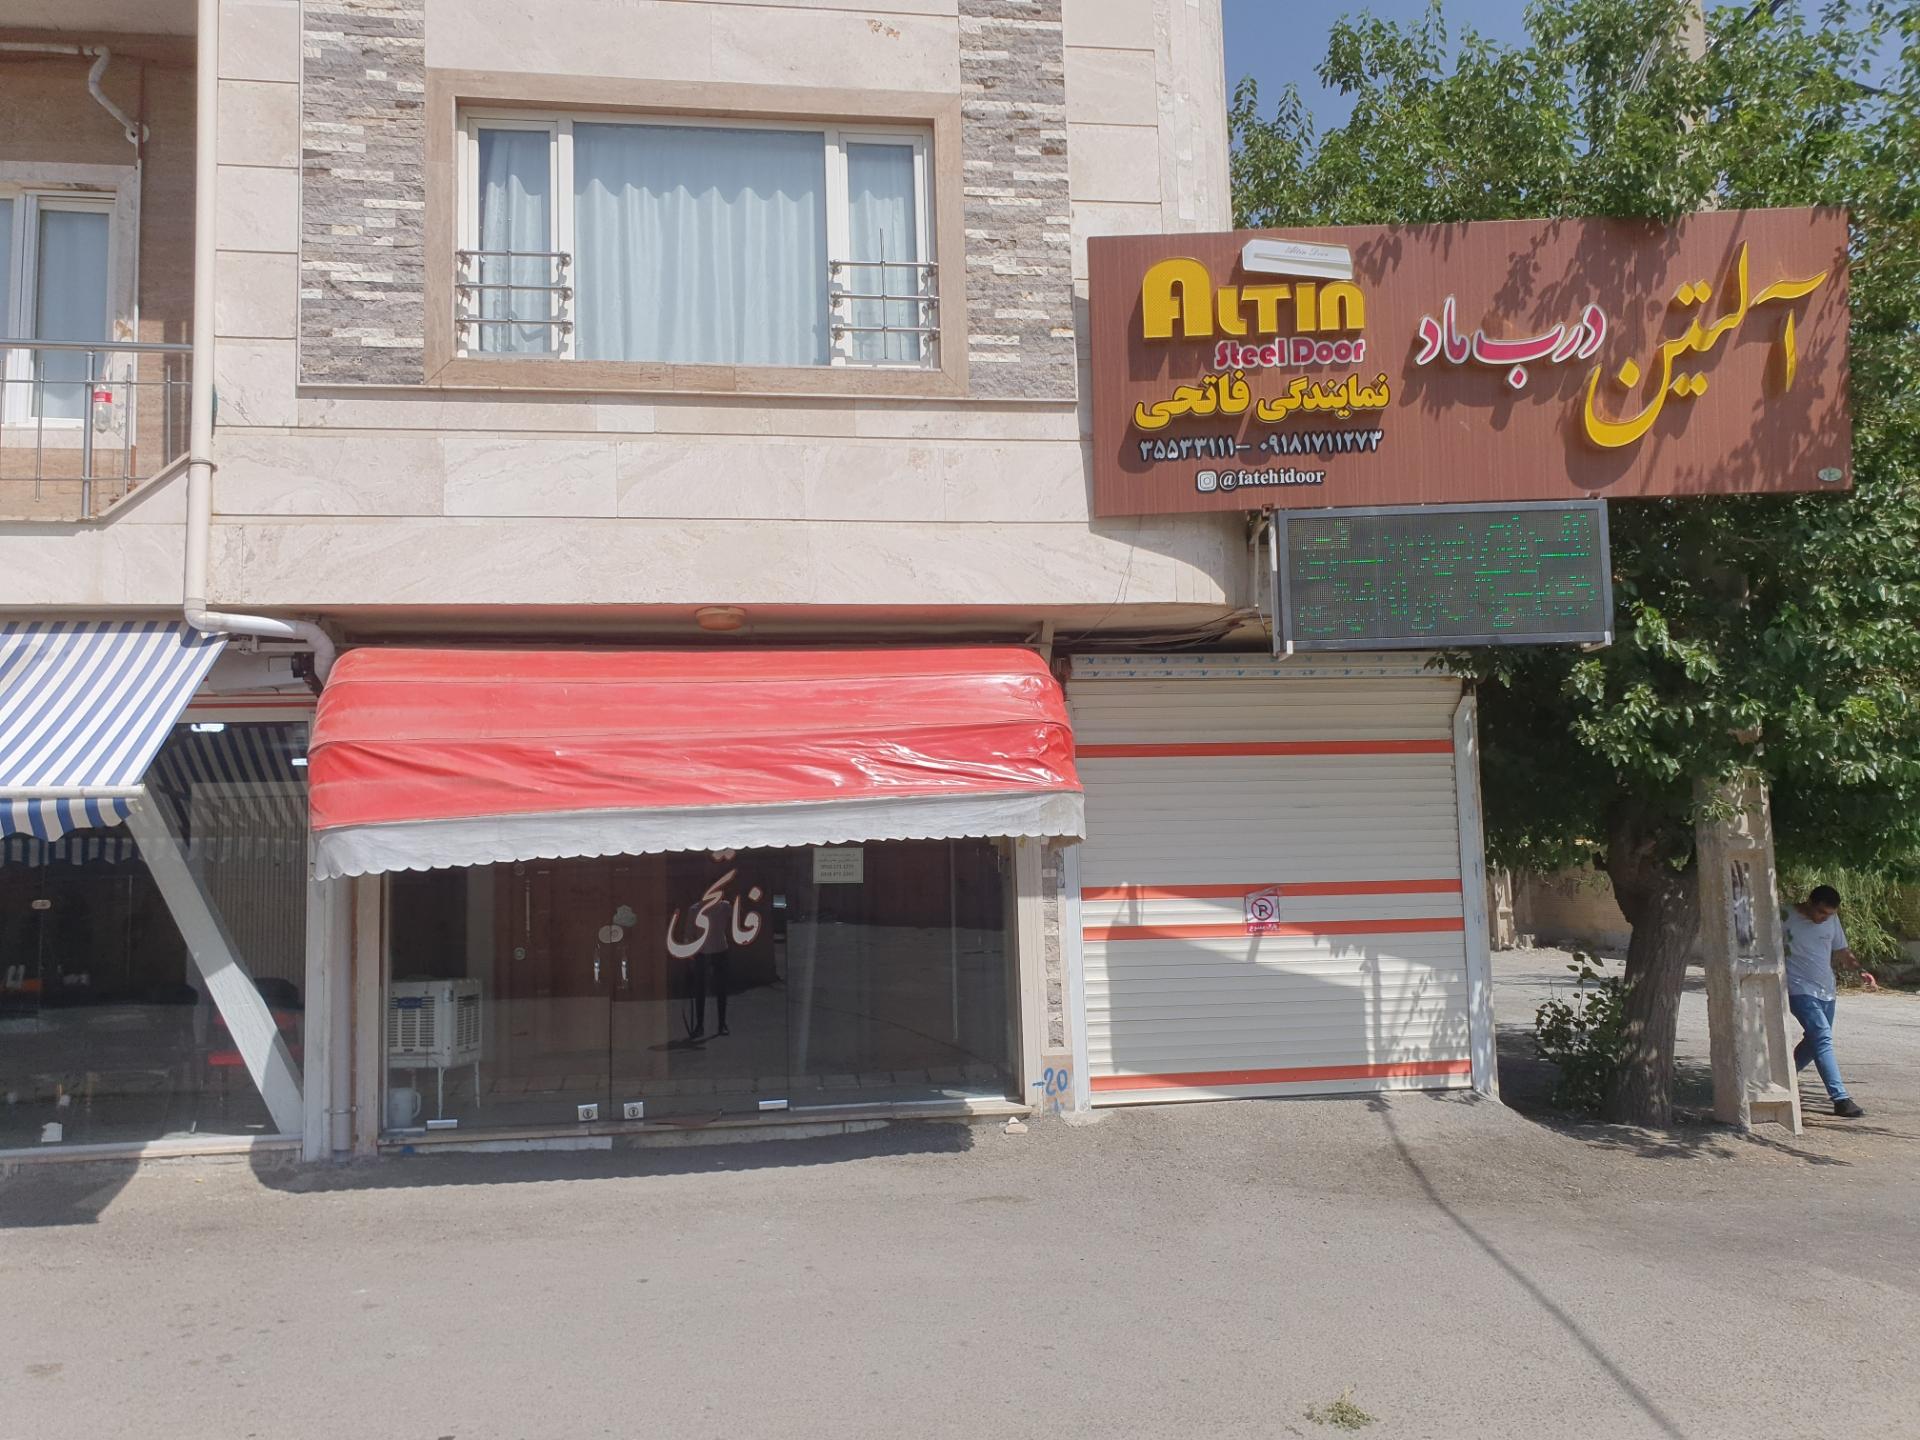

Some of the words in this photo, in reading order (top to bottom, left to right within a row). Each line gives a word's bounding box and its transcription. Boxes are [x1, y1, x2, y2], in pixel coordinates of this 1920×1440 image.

[1213, 337, 1288, 370] Steel
[1290, 336, 1366, 365] Door
[1415, 293, 1471, 366] ماد
[1472, 303, 1607, 390] درب
[1133, 368, 1252, 431] فاتحی
[1256, 371, 1391, 423] نمایندگی
[1218, 467, 1326, 490] @fatehidoor
